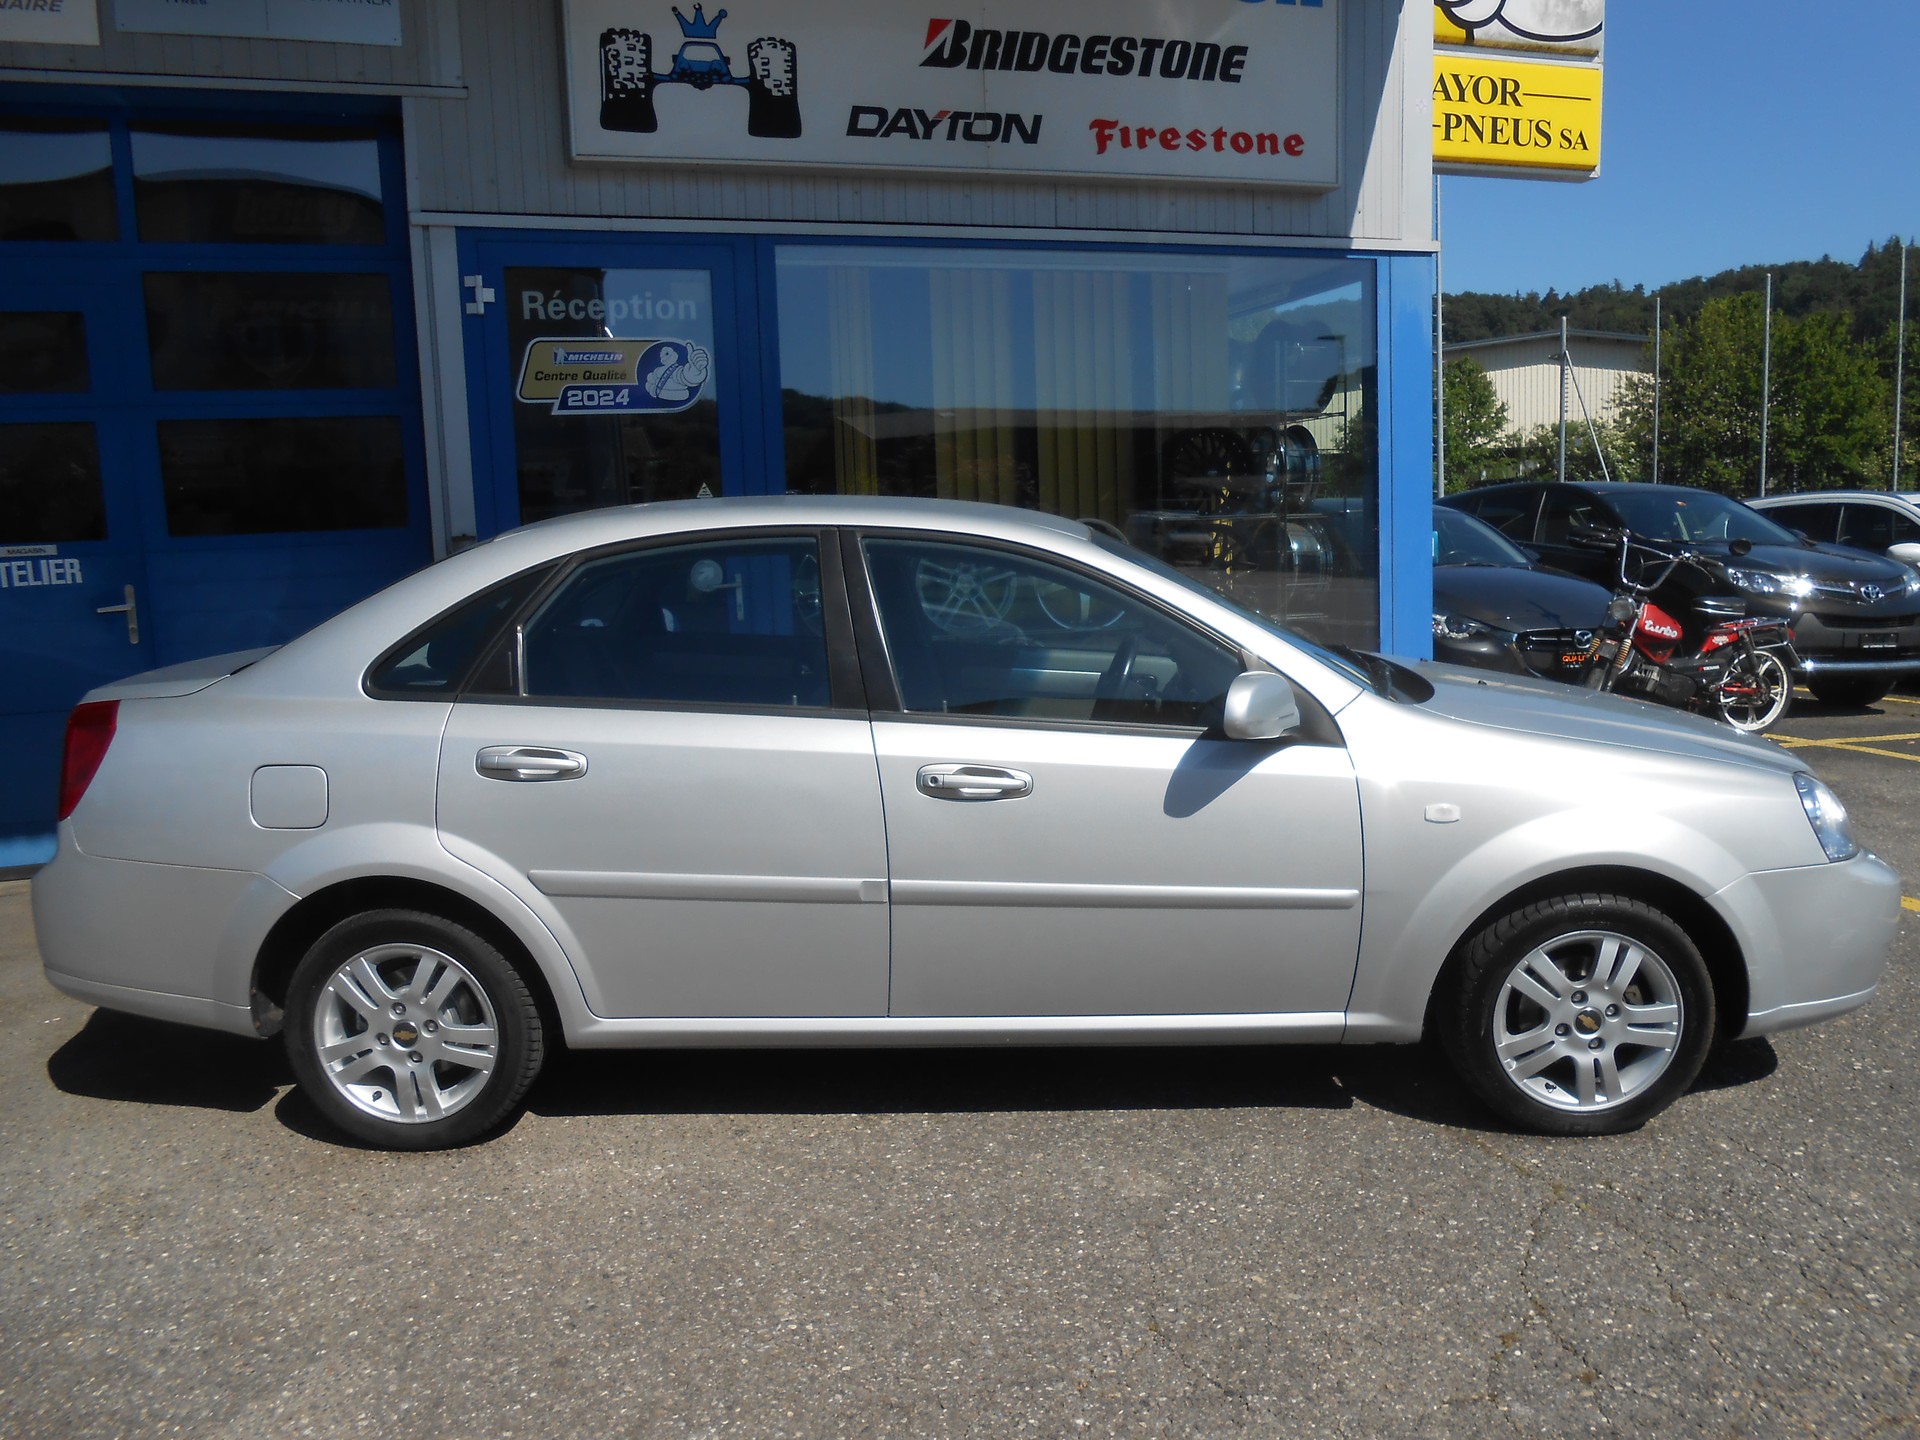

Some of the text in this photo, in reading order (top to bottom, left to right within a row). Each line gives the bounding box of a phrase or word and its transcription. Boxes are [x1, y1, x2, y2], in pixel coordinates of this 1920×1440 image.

[919, 18, 1248, 84] BRIDGESTONE
[846, 105, 1042, 144] DAYTON
[1089, 118, 1305, 157] Firestone
[1560, 129, 1589, 151] SA
[522, 289, 697, 326] Réception
[568, 352, 624, 362] MICHELIN
[534, 369, 627, 382] Centre Qualité
[567, 388, 631, 406] 2024
[1644, 619, 1678, 638] Turbo
